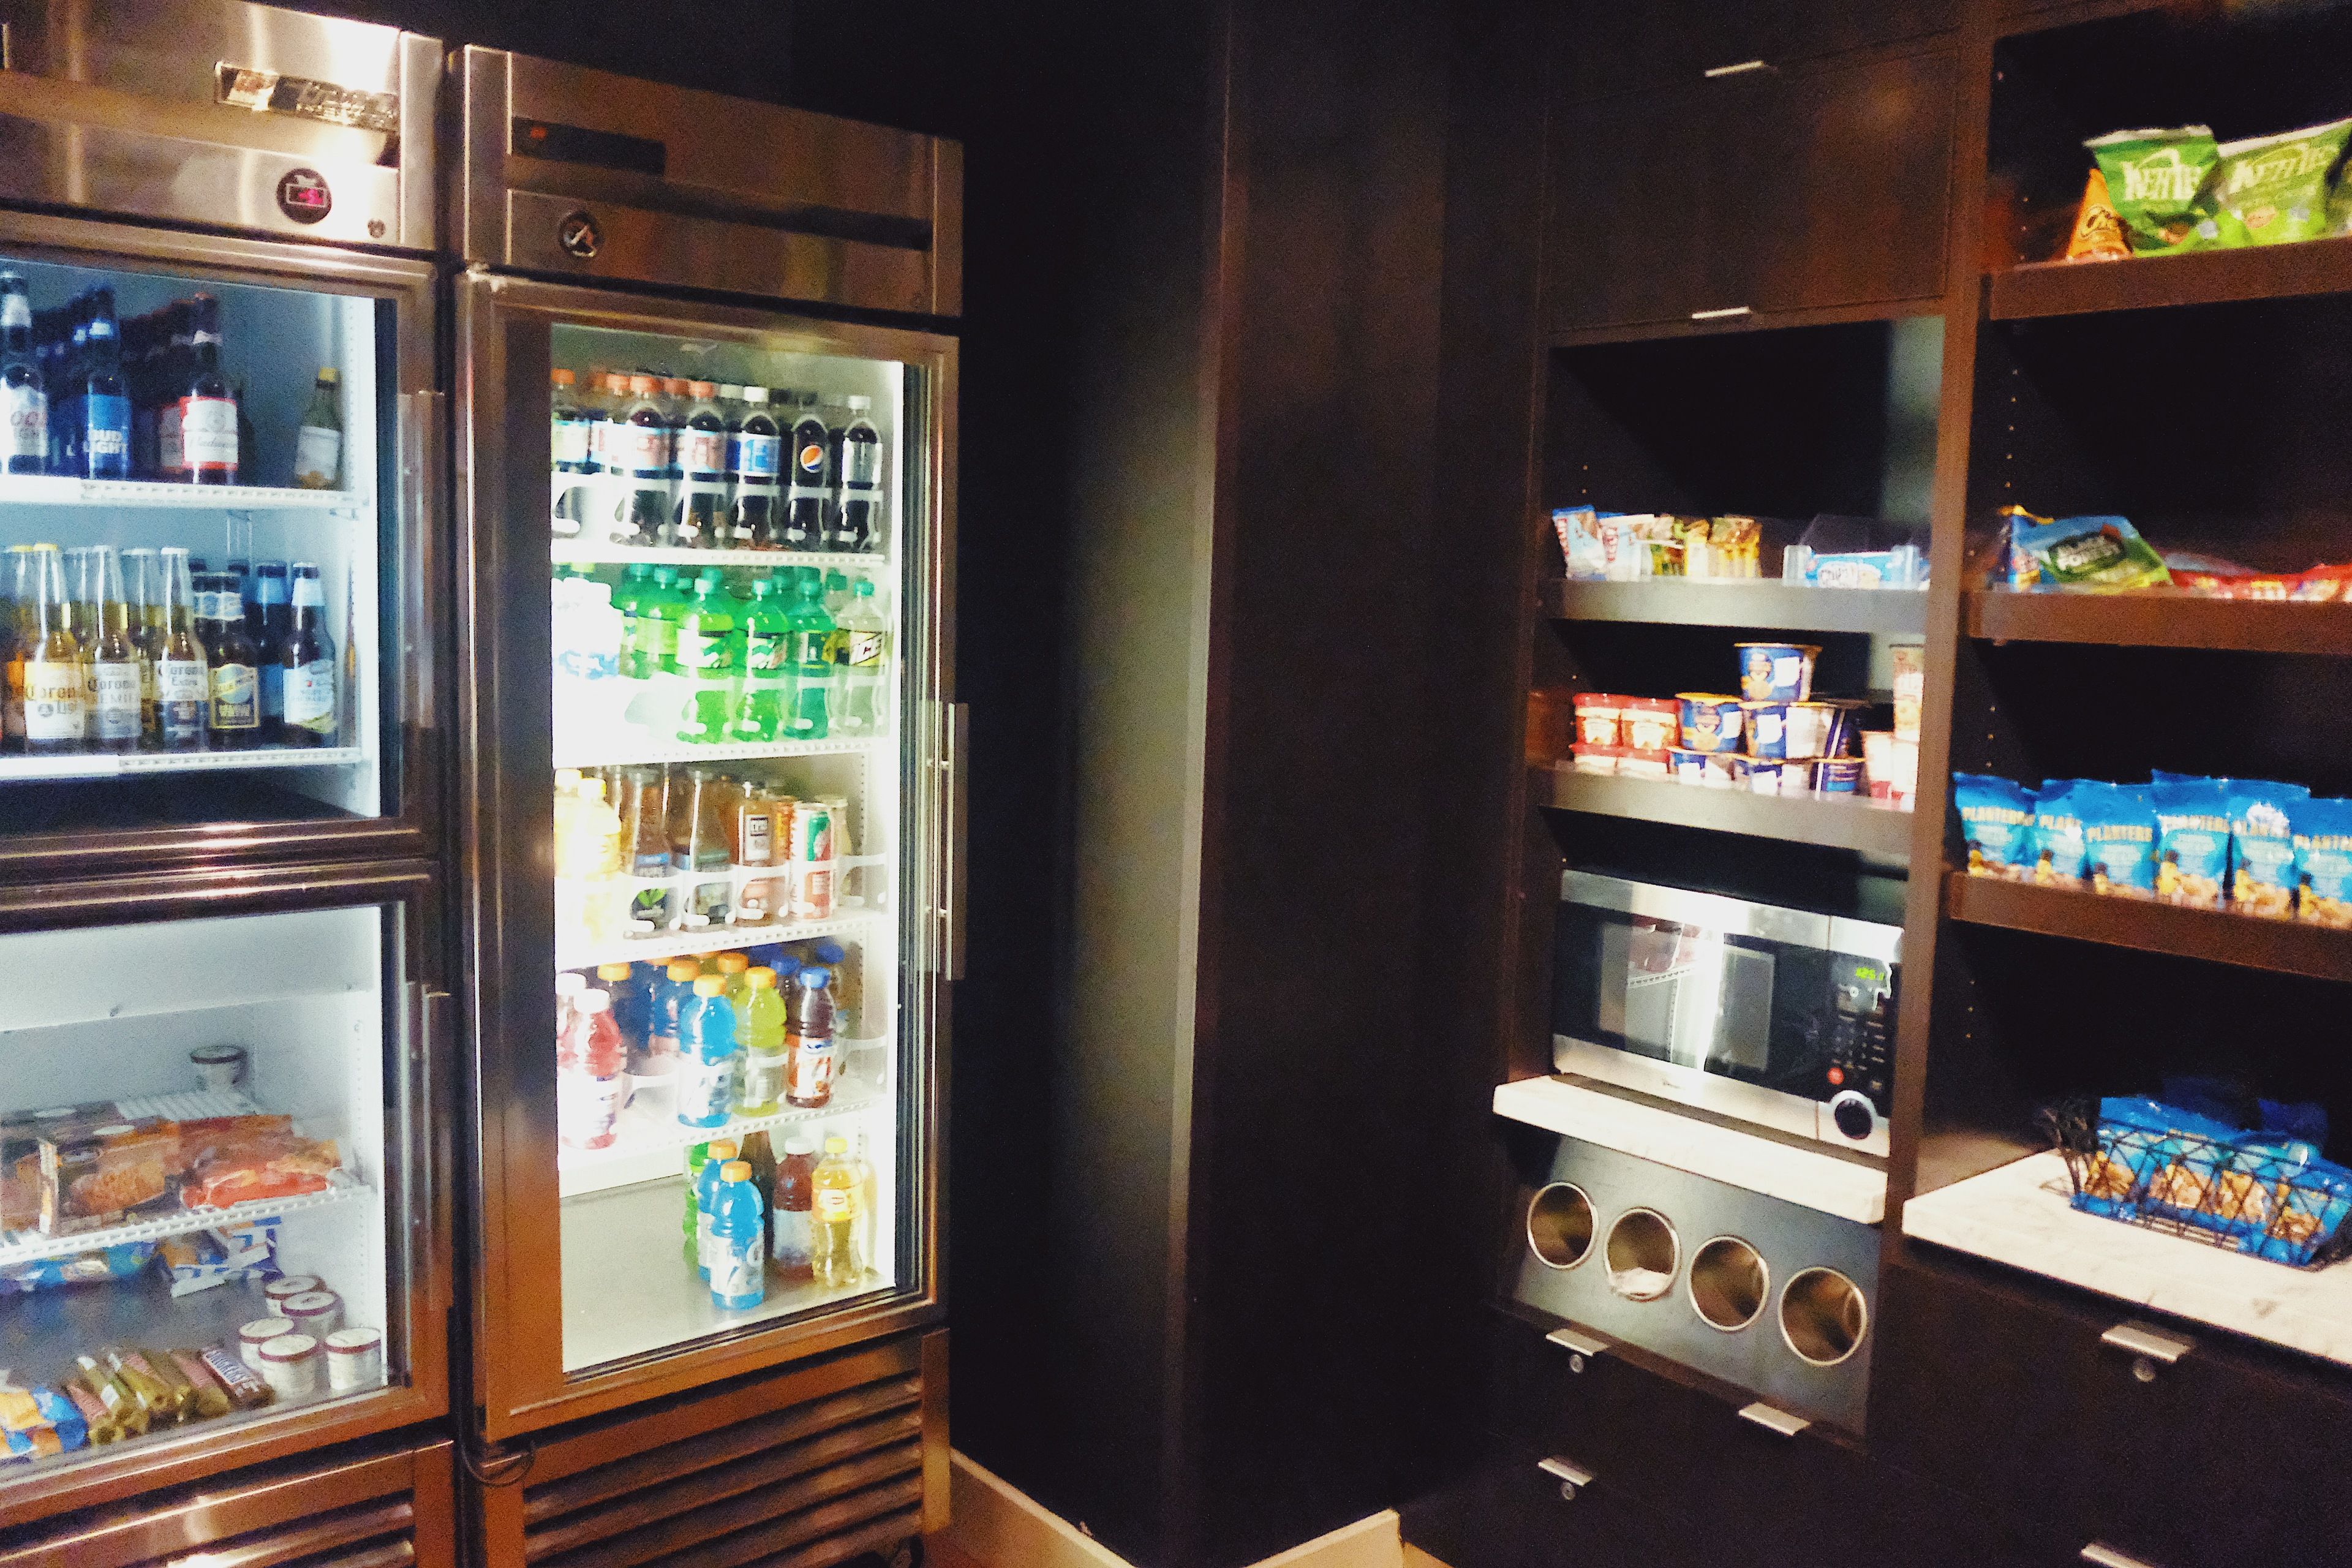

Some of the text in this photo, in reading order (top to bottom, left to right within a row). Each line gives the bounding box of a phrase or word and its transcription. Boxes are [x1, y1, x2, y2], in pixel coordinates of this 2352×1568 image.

[88, 429, 123, 442] BUD
[83, 441, 127, 454] LIGHT
[2087, 825, 2152, 842] PLANTERS
